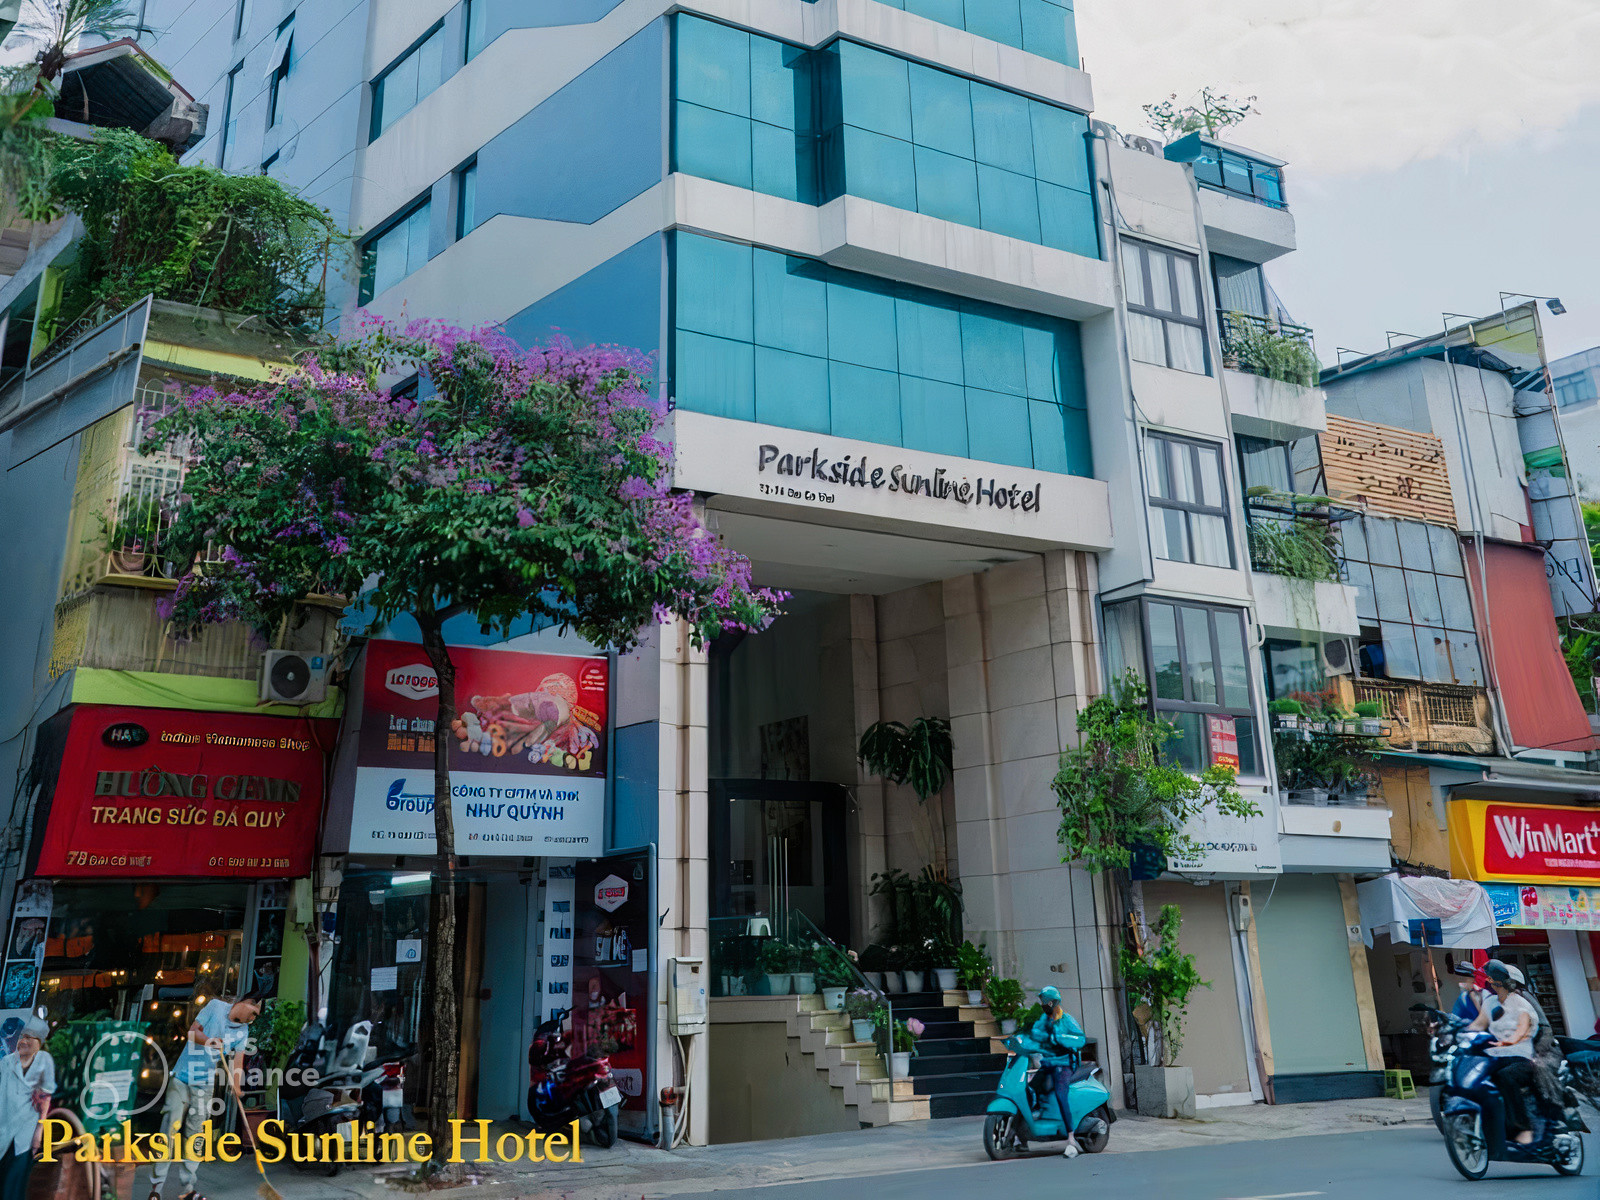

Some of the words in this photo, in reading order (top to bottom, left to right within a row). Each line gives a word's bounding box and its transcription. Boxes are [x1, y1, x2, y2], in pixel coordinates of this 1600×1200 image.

[758, 444, 886, 489] Parkside
[888, 464, 974, 506] Sunline
[975, 476, 1041, 513] Hotel
[92, 806, 162, 824] TRANG
[466, 803, 505, 818] NHƯ
